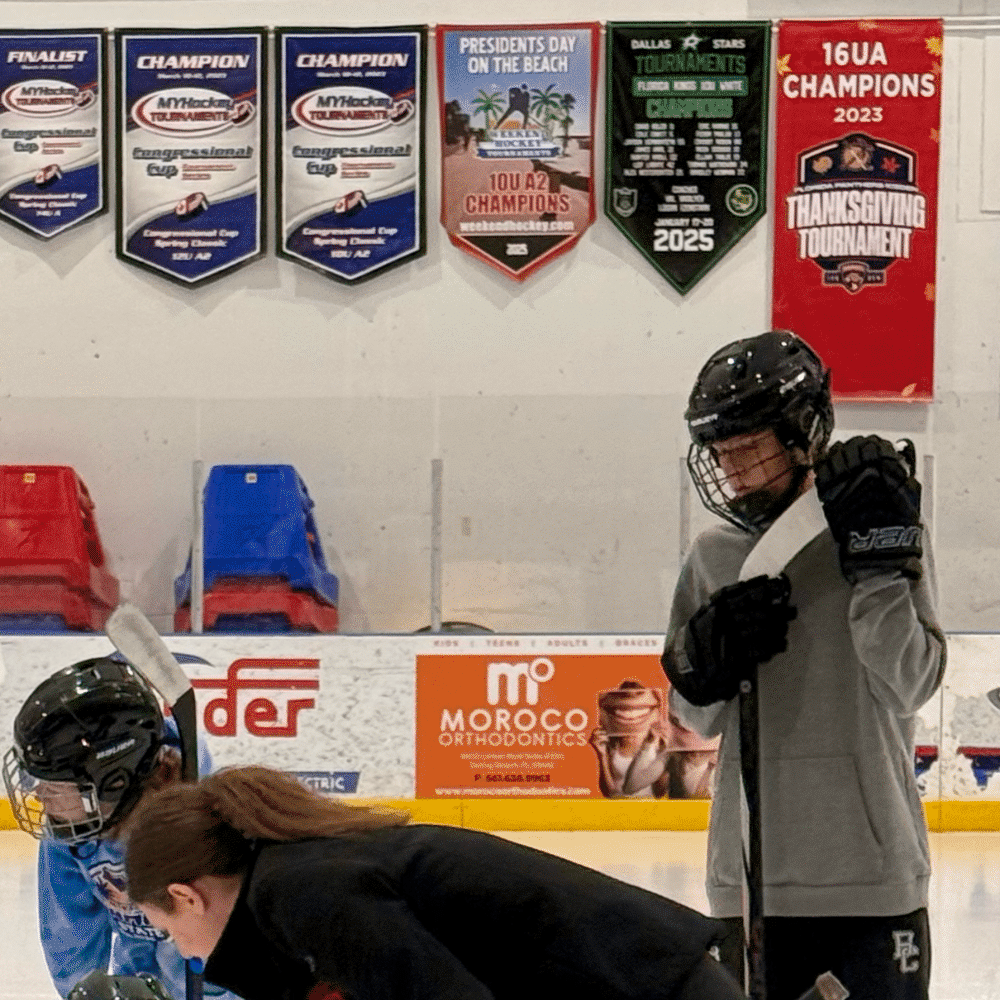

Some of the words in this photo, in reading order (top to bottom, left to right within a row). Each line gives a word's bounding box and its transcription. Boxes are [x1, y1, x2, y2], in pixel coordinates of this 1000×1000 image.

[460, 36, 545, 54] PRESIDENTS
[549, 36, 577, 53] DAY
[631, 39, 672, 49] DALLAS
[712, 39, 746, 49] STARS
[7, 50, 89, 63] FINALIST
[137, 54, 249, 69] CHAMPION
[296, 54, 409, 68] CHAMPION
[822, 42, 887, 66] 16UA
[468, 56, 490, 73] ON
[492, 56, 520, 73] THE
[523, 56, 568, 73] BEACH
[635, 54, 746, 74] TOURNAMENTS
[783, 74, 935, 98] CHAMPIONS
[834, 107, 883, 122] 2023
[1, 127, 97, 140] Congressional
[132, 146, 253, 162] Congressional
[292, 144, 412, 160] Congressional
[146, 163, 178, 179] Cup
[306, 161, 338, 177] Cup
[490, 172, 520, 191] 10U
[525, 172, 547, 191] A2
[465, 193, 570, 214] CHAMPIONS
[787, 190, 926, 229] THANKSGIVING
[460, 220, 575, 232] weekendhockey.com
[654, 229, 715, 252] 2025
[799, 225, 912, 259] TOURNAMENT
[848, 525, 923, 553] UER
[434, 639, 459, 647] KIDS
[547, 639, 588, 647] ADULTS
[440, 708, 588, 731] MOROCO
[438, 732, 588, 747] ORTHODONTICS
